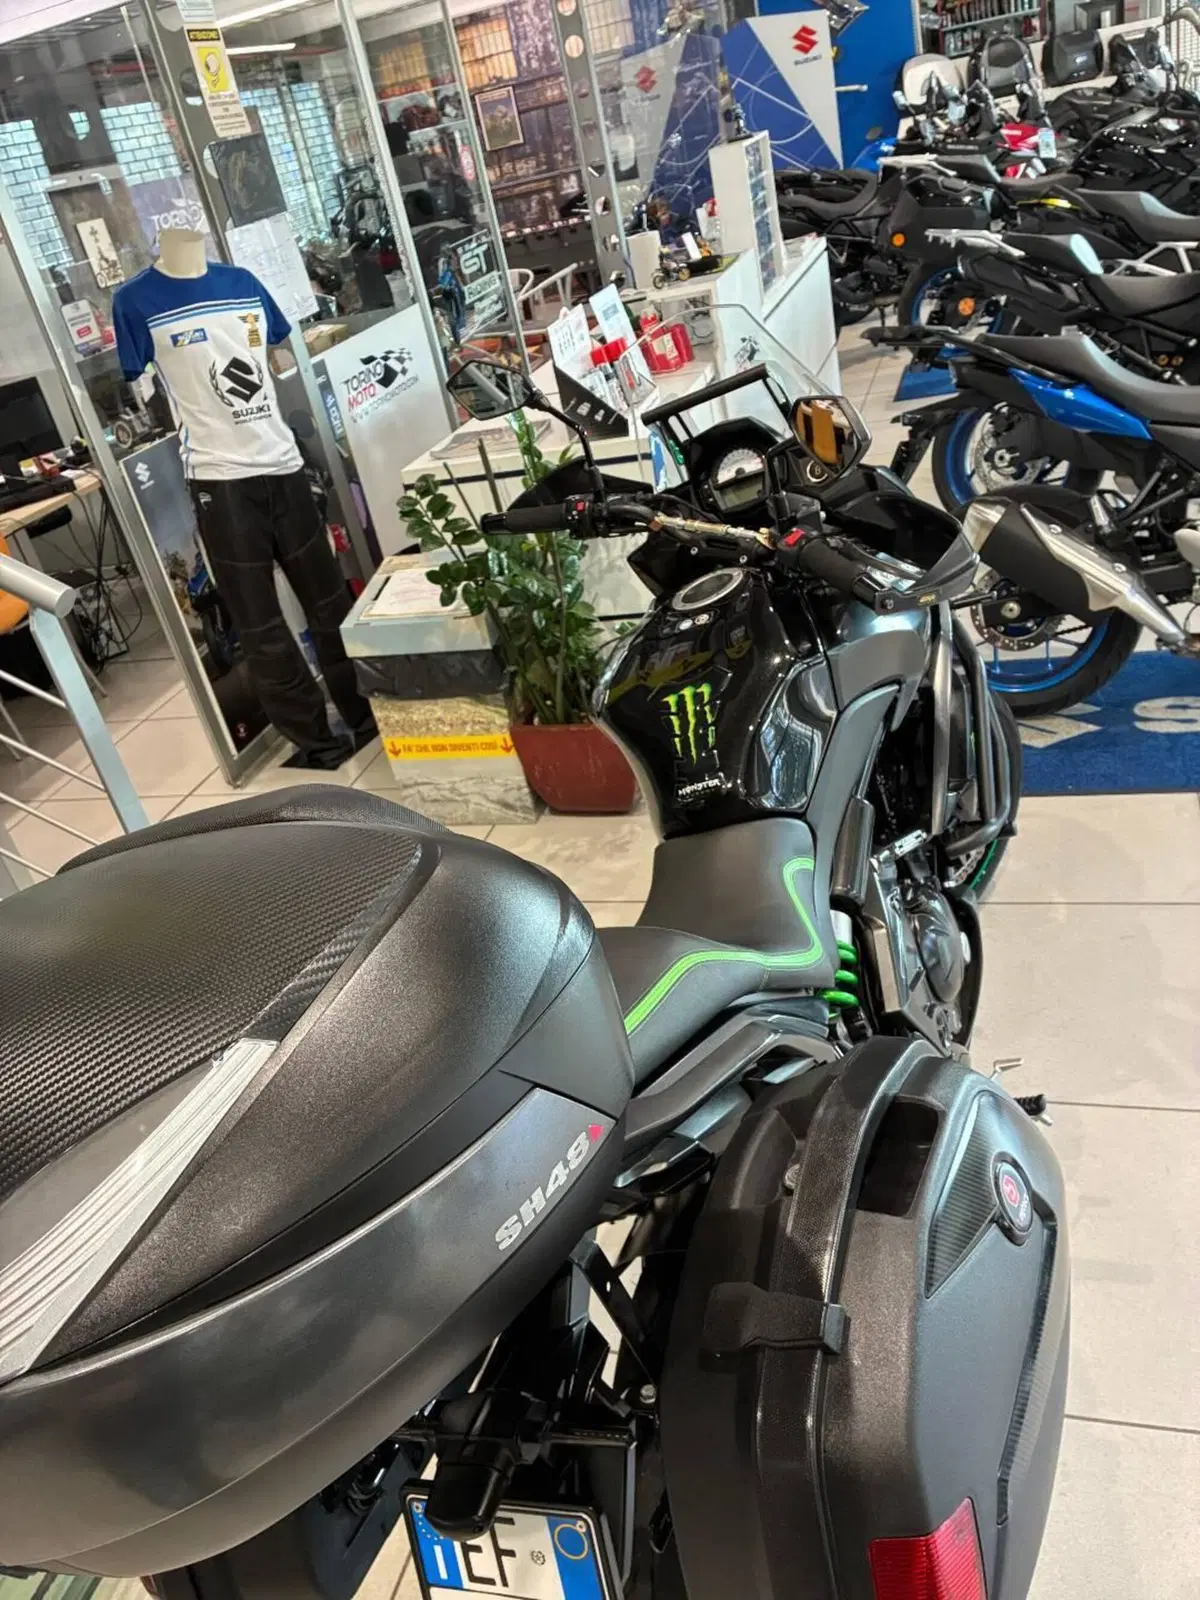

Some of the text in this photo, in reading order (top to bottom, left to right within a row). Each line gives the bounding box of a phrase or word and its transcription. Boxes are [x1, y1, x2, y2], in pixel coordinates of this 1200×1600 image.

[341, 361, 385, 395] TORINO
[347, 382, 376, 412] MOTO
[678, 779, 720, 795] MONSTER
[495, 1131, 590, 1251] SH48
